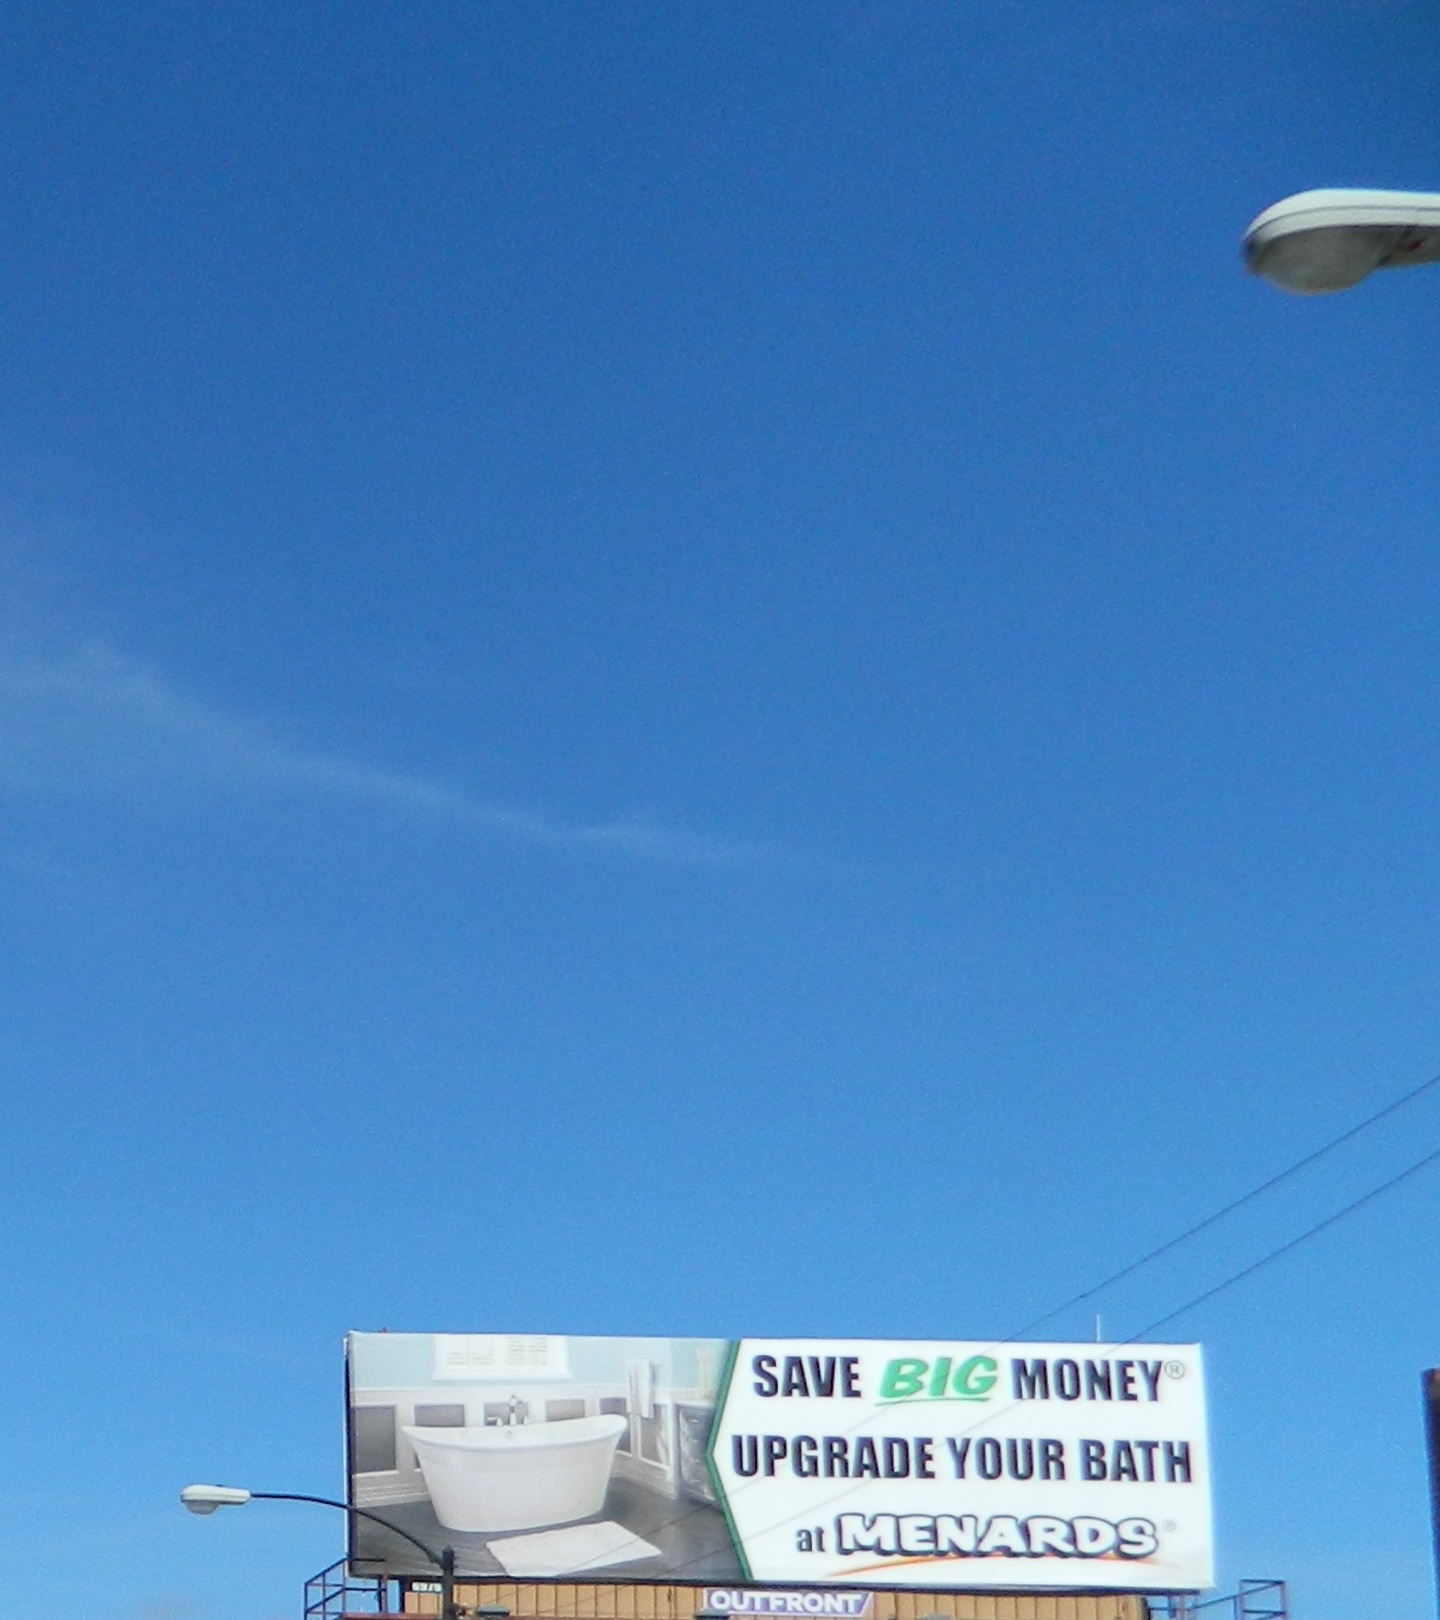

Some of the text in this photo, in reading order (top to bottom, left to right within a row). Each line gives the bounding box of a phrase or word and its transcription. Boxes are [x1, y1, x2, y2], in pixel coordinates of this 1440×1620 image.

[751, 1355, 862, 1398] SAVE
[878, 1355, 998, 1399] BIG
[731, 1434, 1192, 1483] UPGRADE YOUR BATH
[795, 1512, 1159, 1560] at MENARDS
[709, 1590, 864, 1614] OUTFRONT
